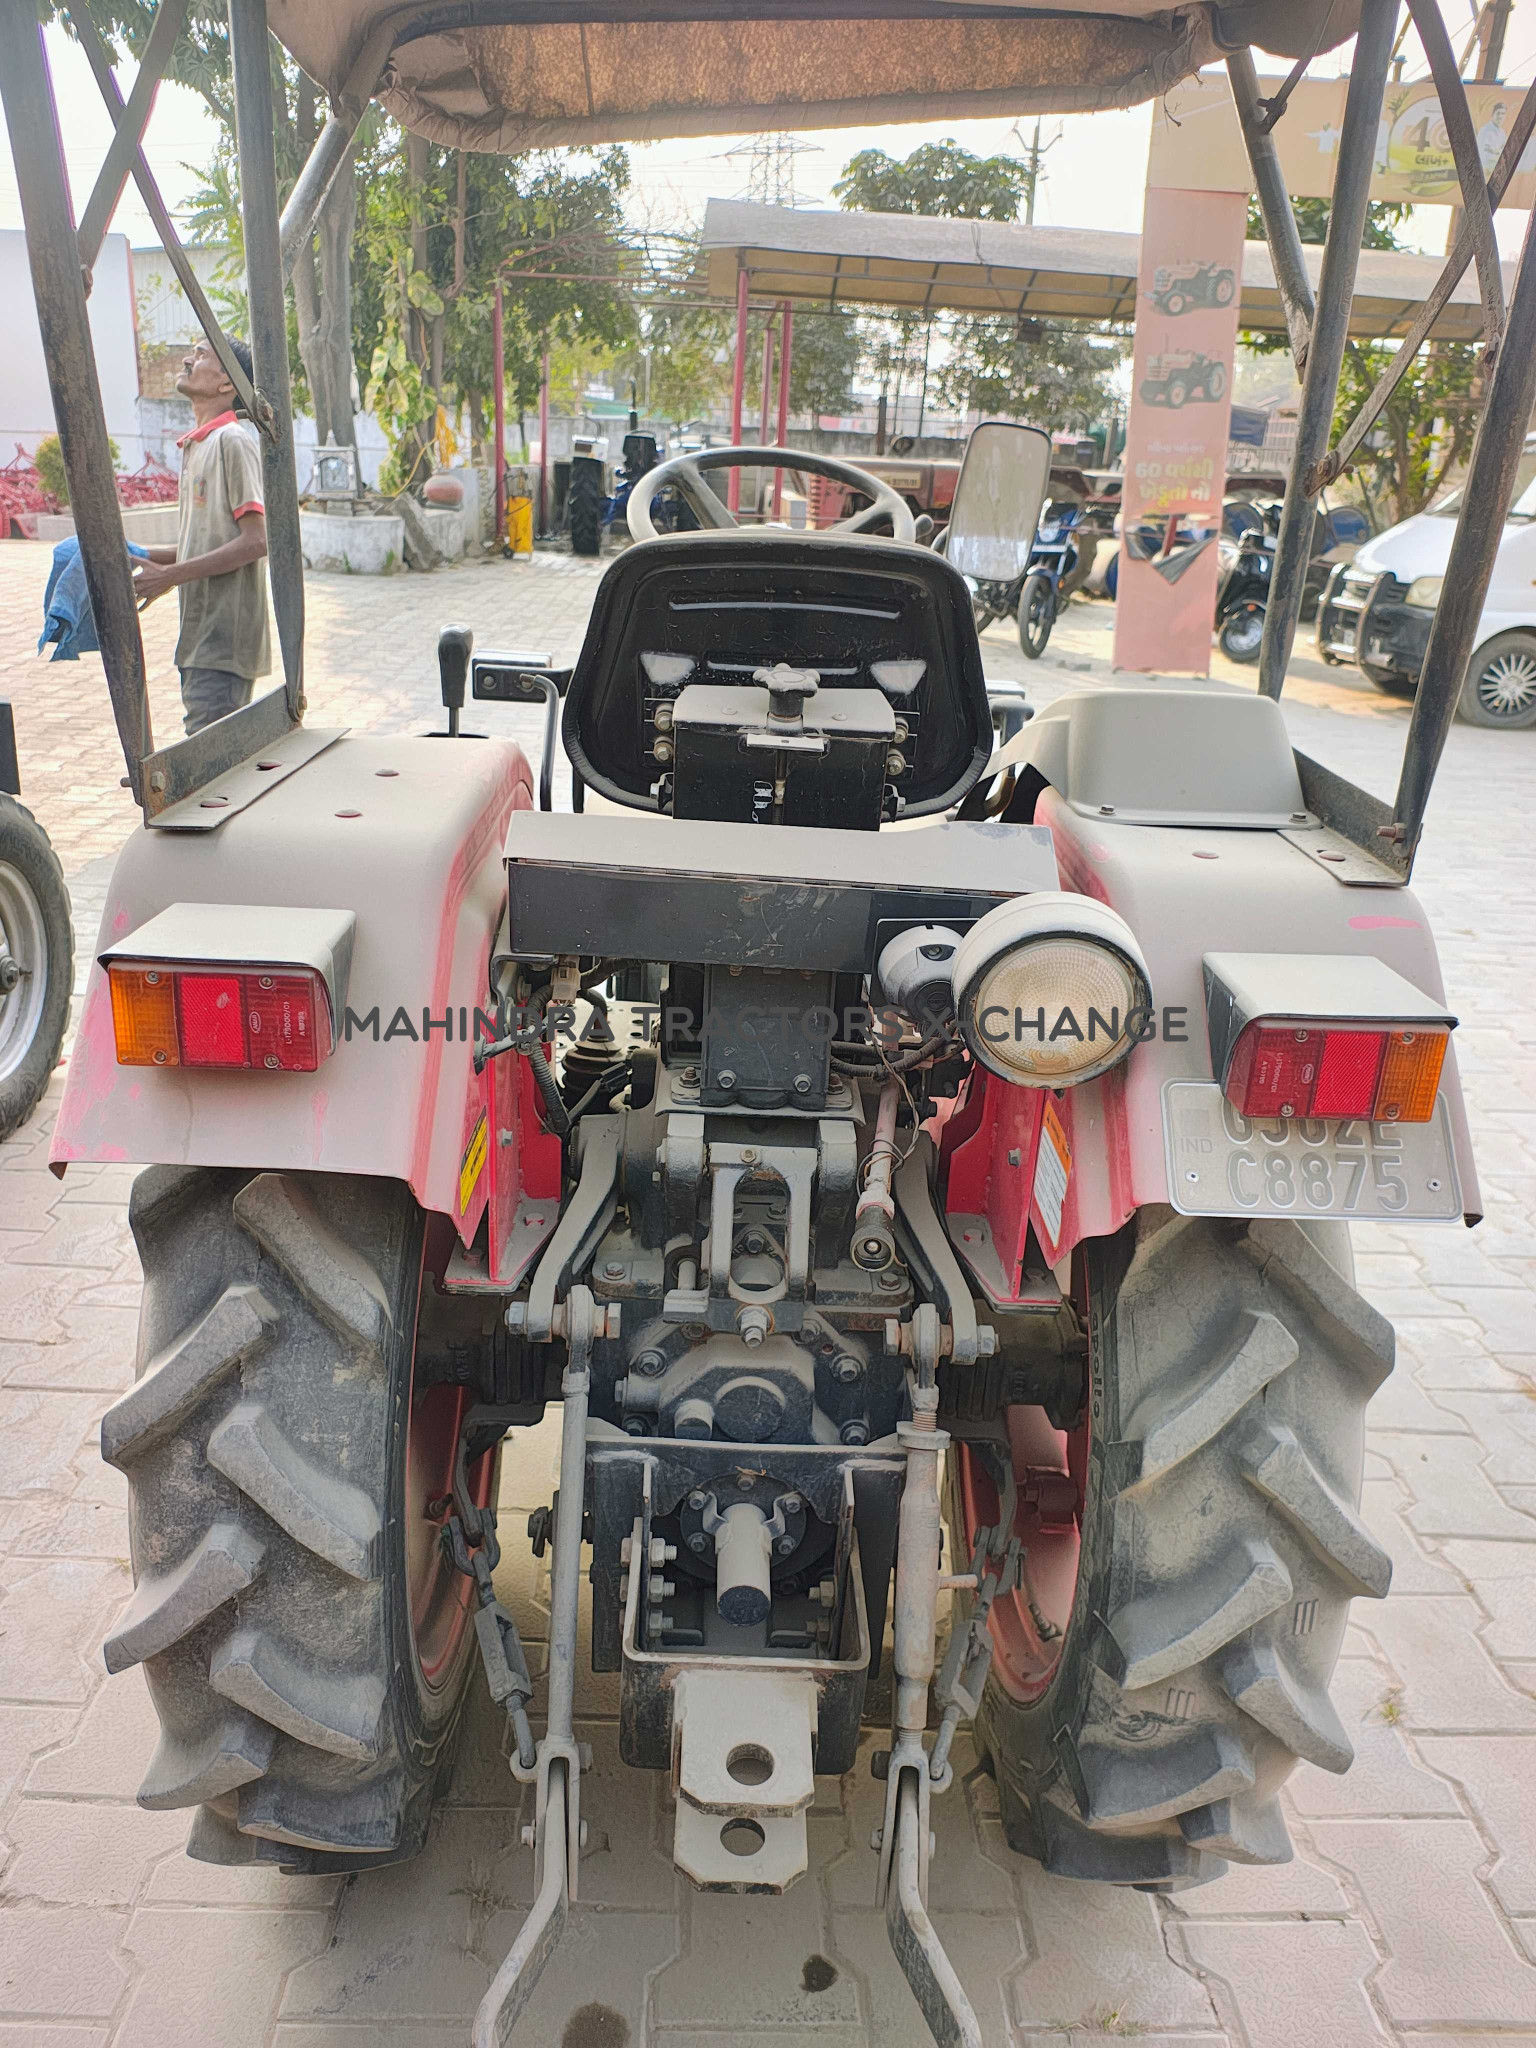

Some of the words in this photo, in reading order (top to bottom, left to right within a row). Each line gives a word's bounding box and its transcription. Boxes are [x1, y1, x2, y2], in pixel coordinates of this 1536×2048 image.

[1137, 462, 1162, 478] 60
[1180, 1138, 1213, 1154] IND
[1228, 1149, 1409, 1212] C8875
[1092, 1313, 1102, 1418] apollo
